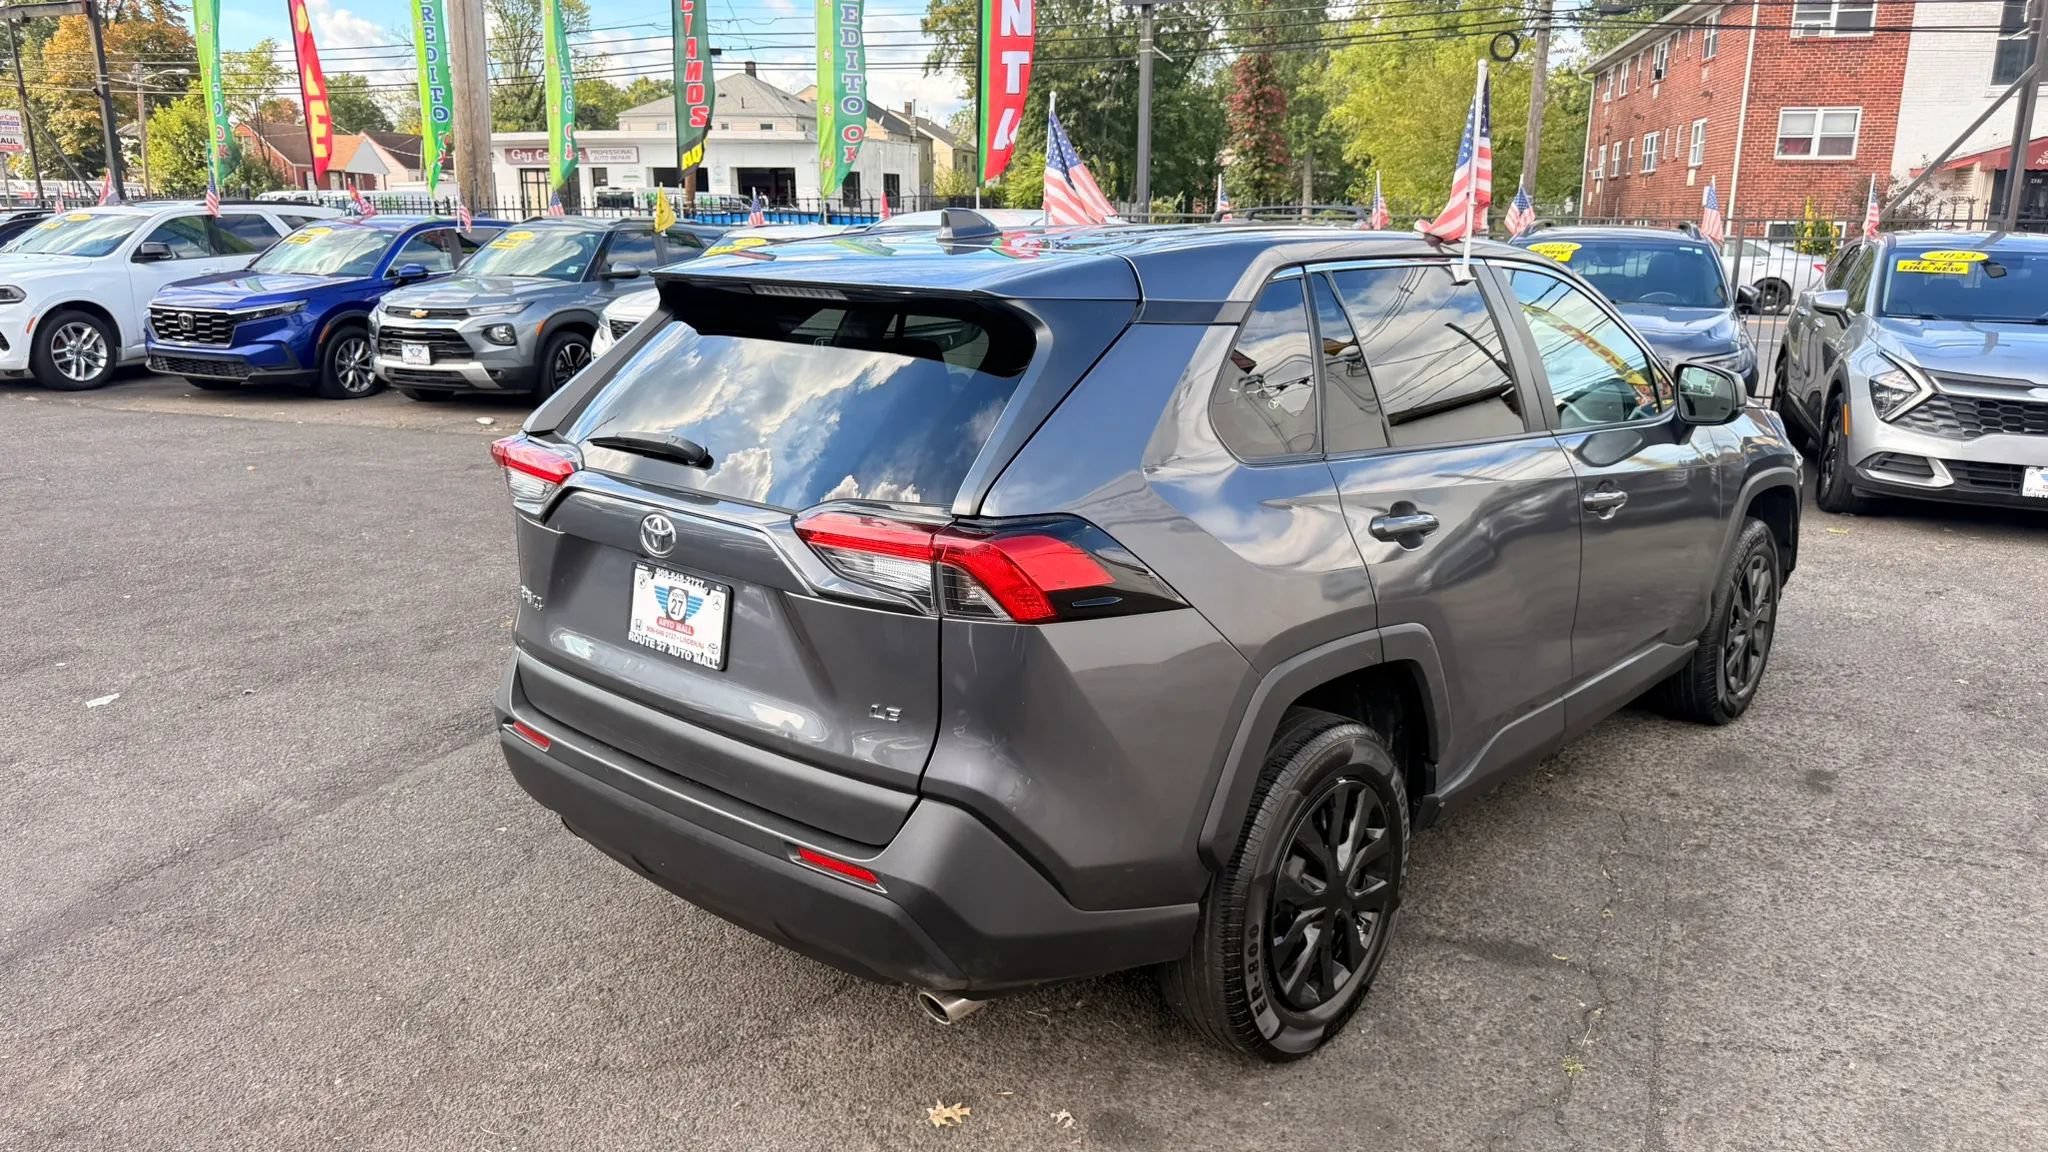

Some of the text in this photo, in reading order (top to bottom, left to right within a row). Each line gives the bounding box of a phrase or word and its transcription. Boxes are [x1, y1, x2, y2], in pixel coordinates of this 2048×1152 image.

[420, 0, 449, 123] REDITO
[840, 0, 865, 164] EDITO OK
[1933, 265, 1965, 273] NEW
[670, 599, 684, 617] 27
[628, 631, 719, 670] ROUTE 27 AUTO MALL
[869, 703, 901, 722] LE
